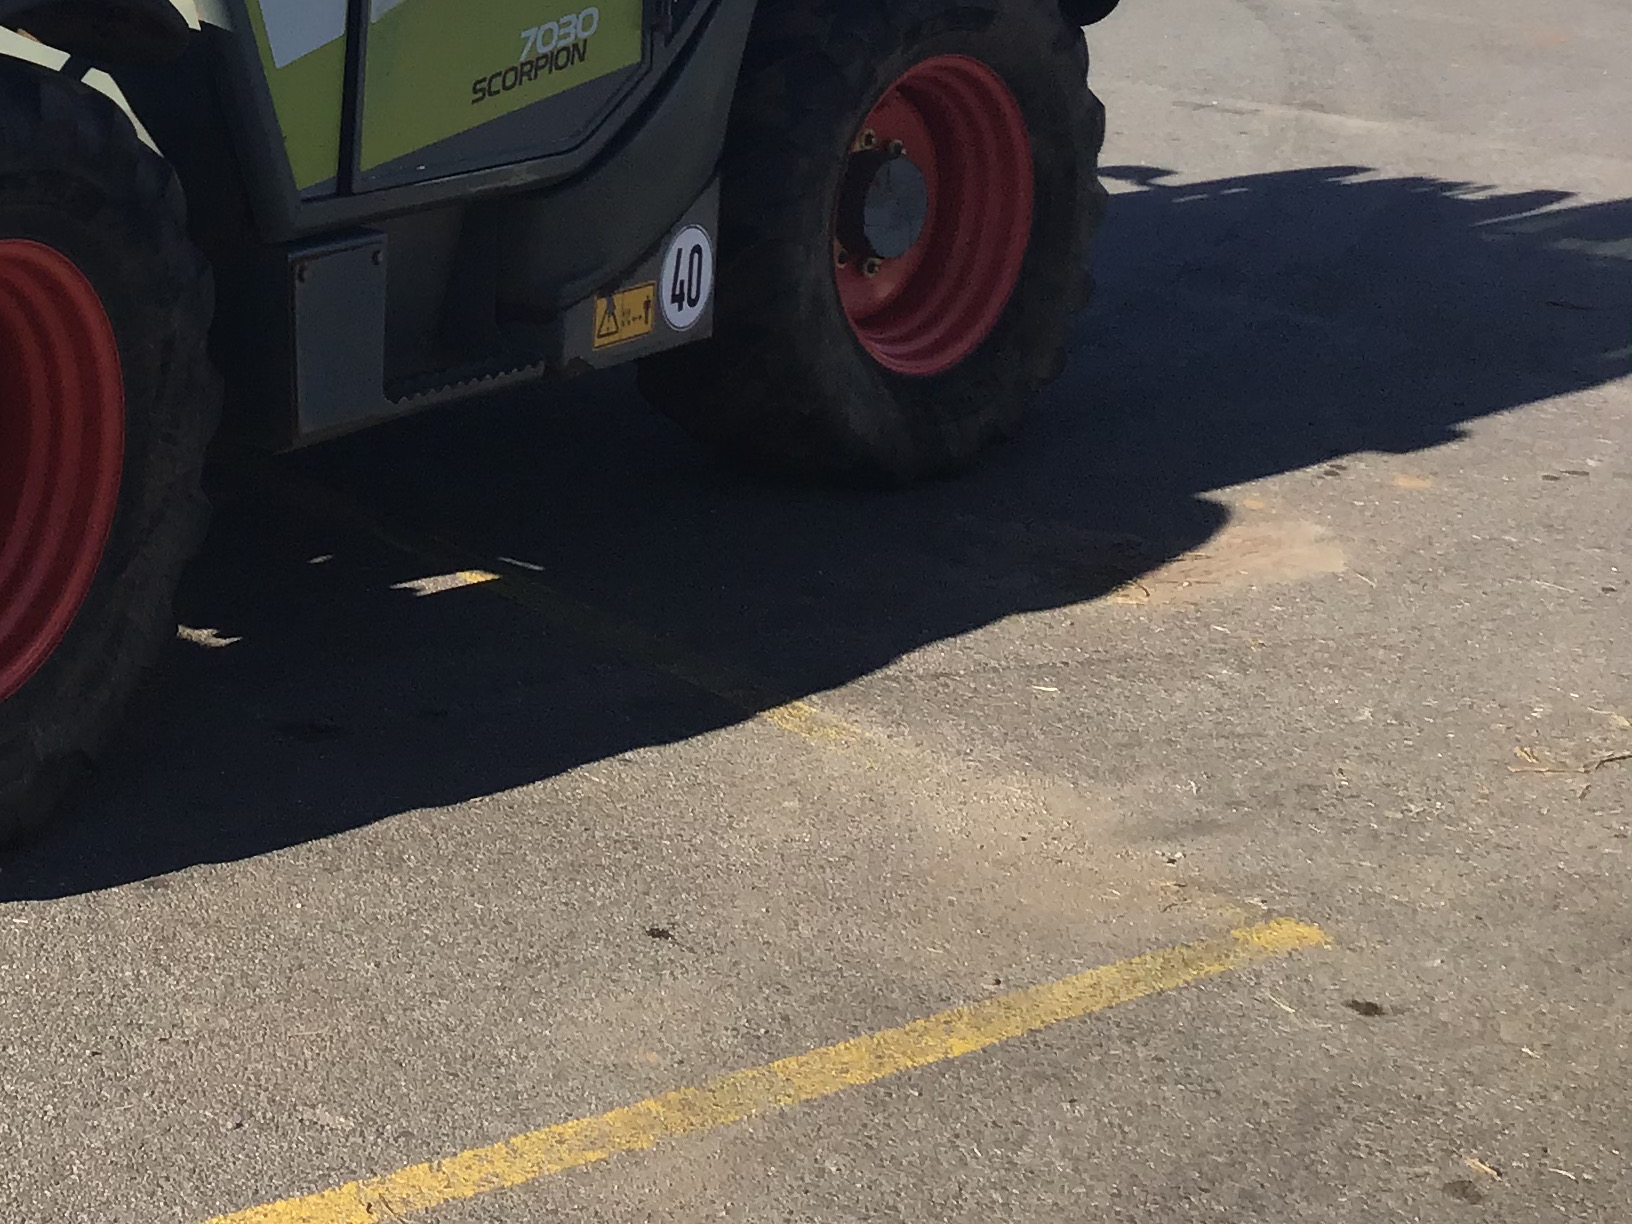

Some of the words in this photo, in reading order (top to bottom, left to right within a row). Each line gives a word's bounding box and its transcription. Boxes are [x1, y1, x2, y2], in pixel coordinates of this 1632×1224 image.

[519, 6, 600, 62] 7030
[471, 38, 588, 105] SCORPION
[670, 243, 703, 313] 40
